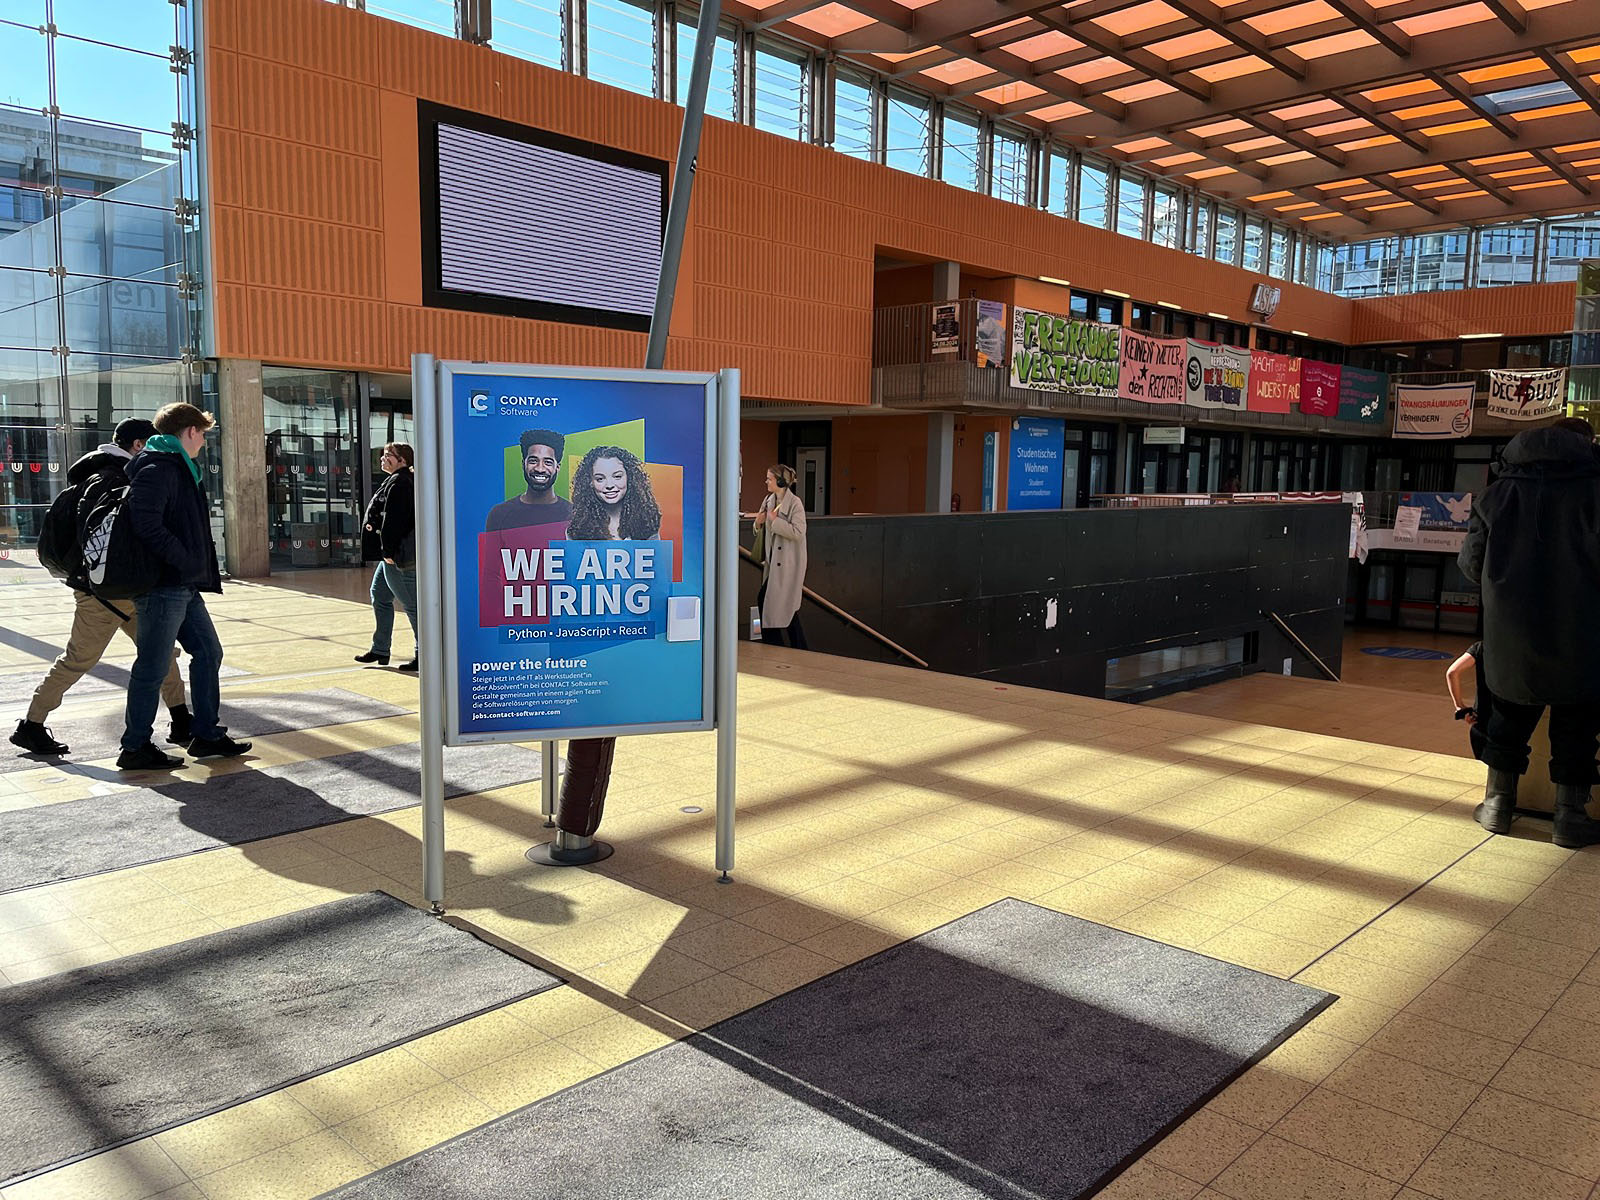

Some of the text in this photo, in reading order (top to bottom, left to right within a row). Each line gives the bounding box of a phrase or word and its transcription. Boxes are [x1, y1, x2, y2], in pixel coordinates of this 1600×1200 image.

[1125, 336, 1180, 366] KEINEN METER
[1015, 350, 1119, 389] VERTEIDIGEN
[1250, 355, 1275, 372] MACHT
[1288, 358, 1301, 372] WUT
[1129, 376, 1144, 396] den
[1148, 374, 1178, 399] RECHTEN
[1257, 380, 1300, 400] WIDERSTAND
[500, 396, 558, 407] CONTACT
[500, 408, 538, 416] Software
[1400, 414, 1440, 423] VERHINDERN
[1017, 448, 1056, 458] Studentisches
[1024, 462, 1048, 472] Wohnen
[501, 548, 654, 580] WE ARE
[504, 584, 650, 617] HIRING
[508, 626, 648, 641] Python JavaScript React
[472, 658, 588, 674] power the future
[472, 676, 492, 684] Steige
[500, 692, 536, 700] gemeinsam
[564, 689, 584, 697] agilen
[484, 700, 540, 709] Softwarelösungen
[472, 710, 561, 720] jobs.contact-software.com
